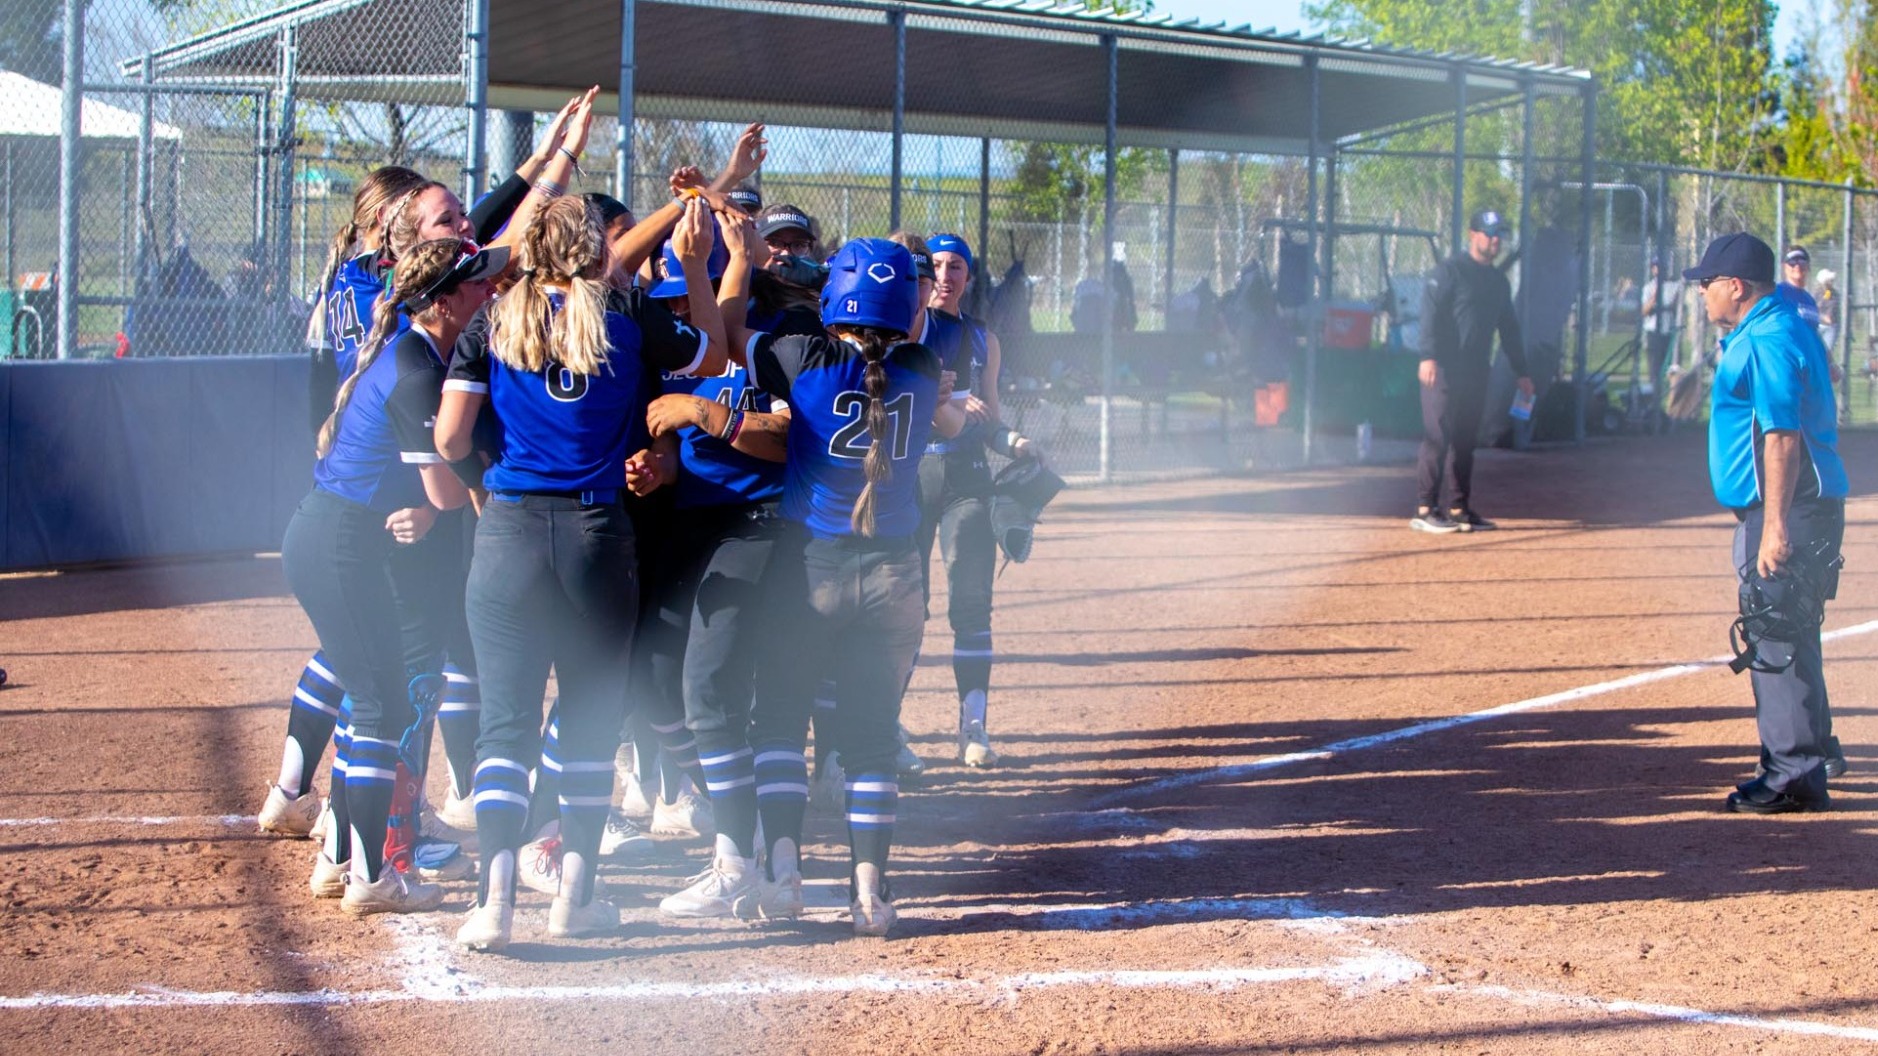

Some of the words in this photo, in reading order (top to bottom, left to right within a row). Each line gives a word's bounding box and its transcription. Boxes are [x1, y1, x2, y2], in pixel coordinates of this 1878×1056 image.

[728, 191, 759, 202] RRIORS
[767, 212, 808, 227] WARRIORS
[846, 299, 858, 313] 21
[329, 286, 365, 351] 14
[828, 390, 914, 460] 21
